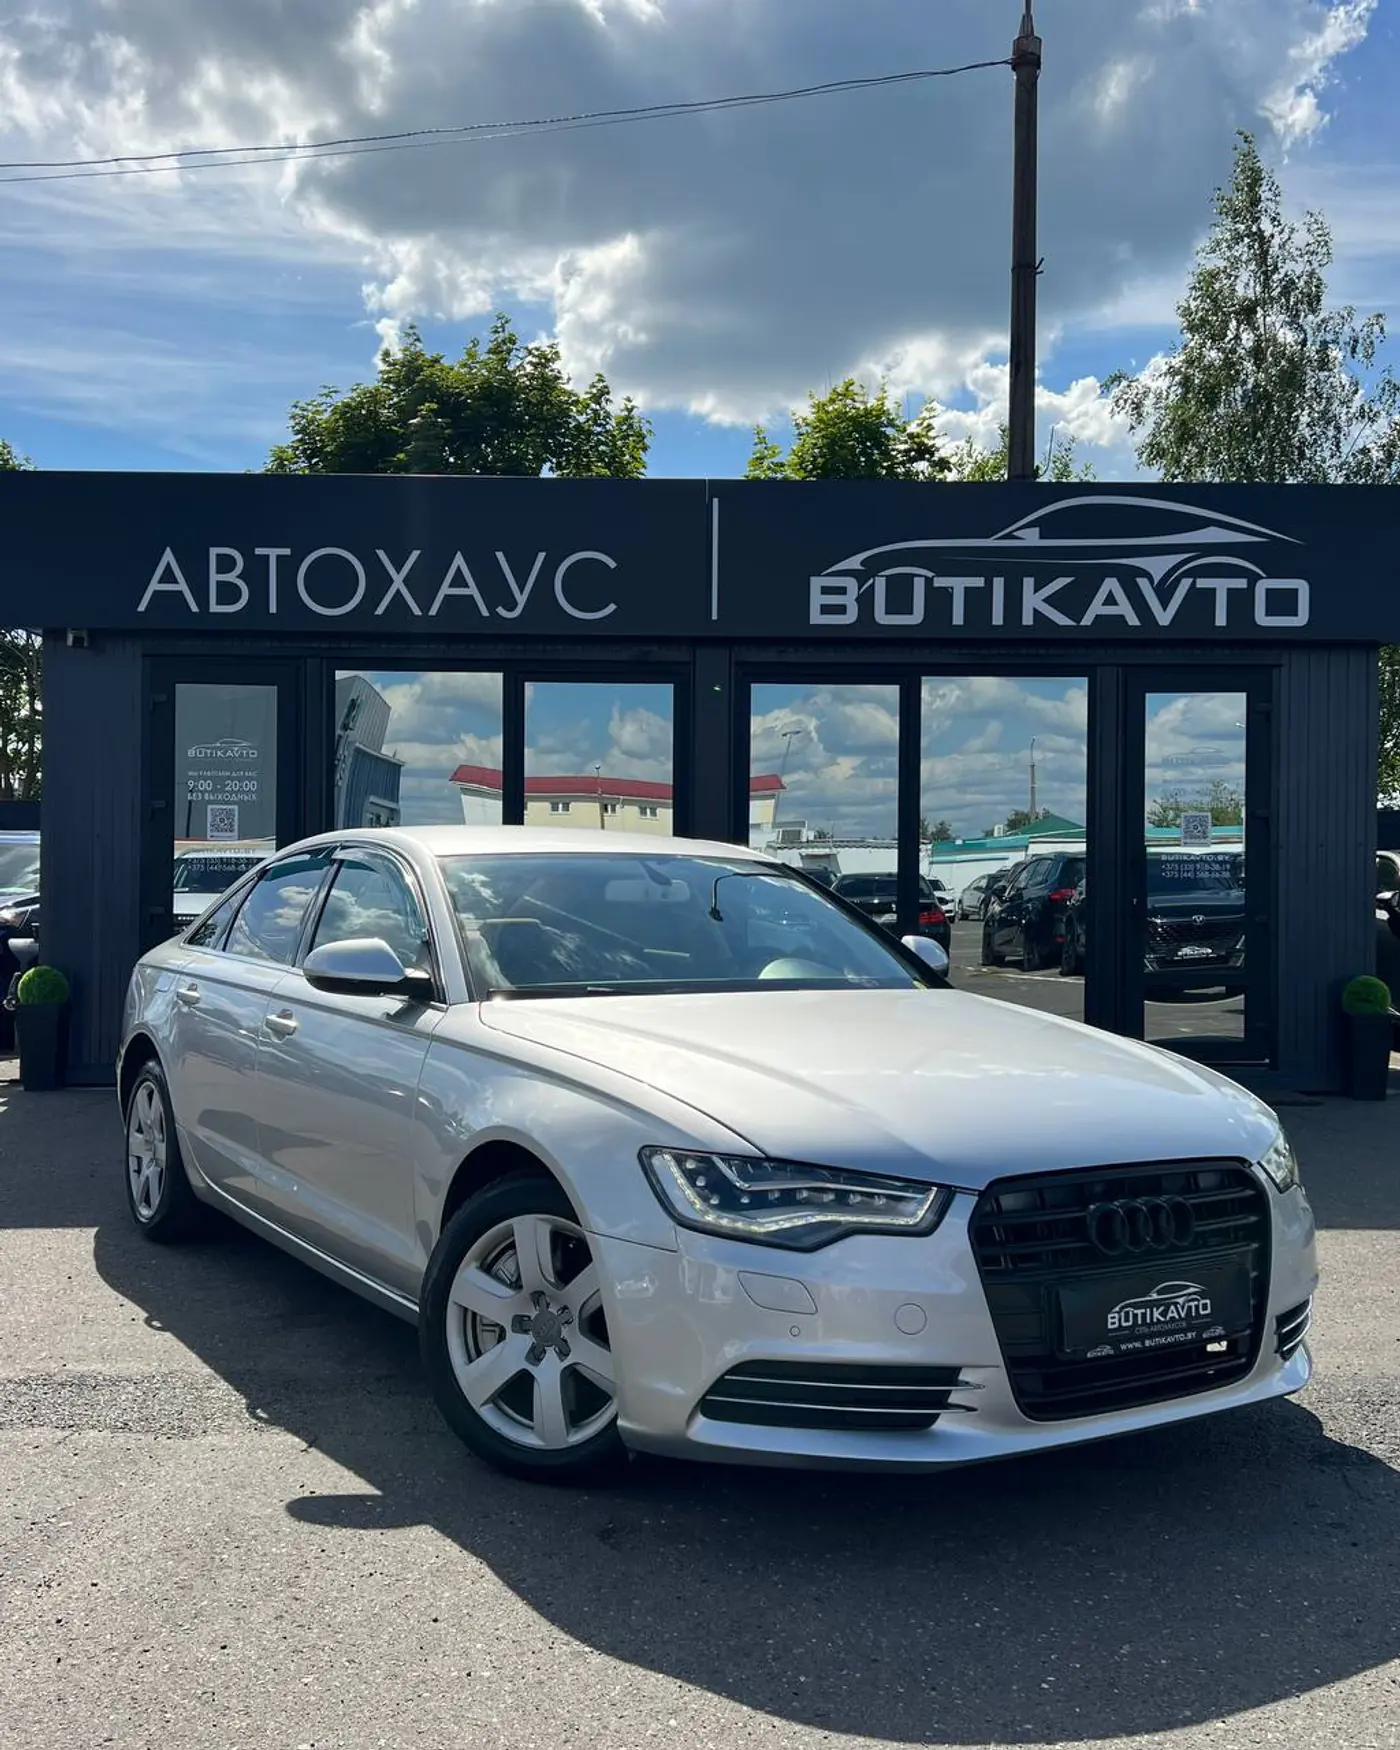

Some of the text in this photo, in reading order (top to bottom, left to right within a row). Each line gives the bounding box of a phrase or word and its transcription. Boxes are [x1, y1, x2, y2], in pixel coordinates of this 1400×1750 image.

[137, 546, 618, 620] АВТОХАУС
[809, 576, 1310, 627] BUTIKAVTO
[187, 749, 258, 758] BUTIKAVTO
[187, 780, 213, 791] 9:00
[225, 780, 257, 791] 20:00
[187, 792, 257, 801] БЕЗ ВЫХОДНЫХ
[1107, 1299, 1212, 1329] BUTIKAVTO
